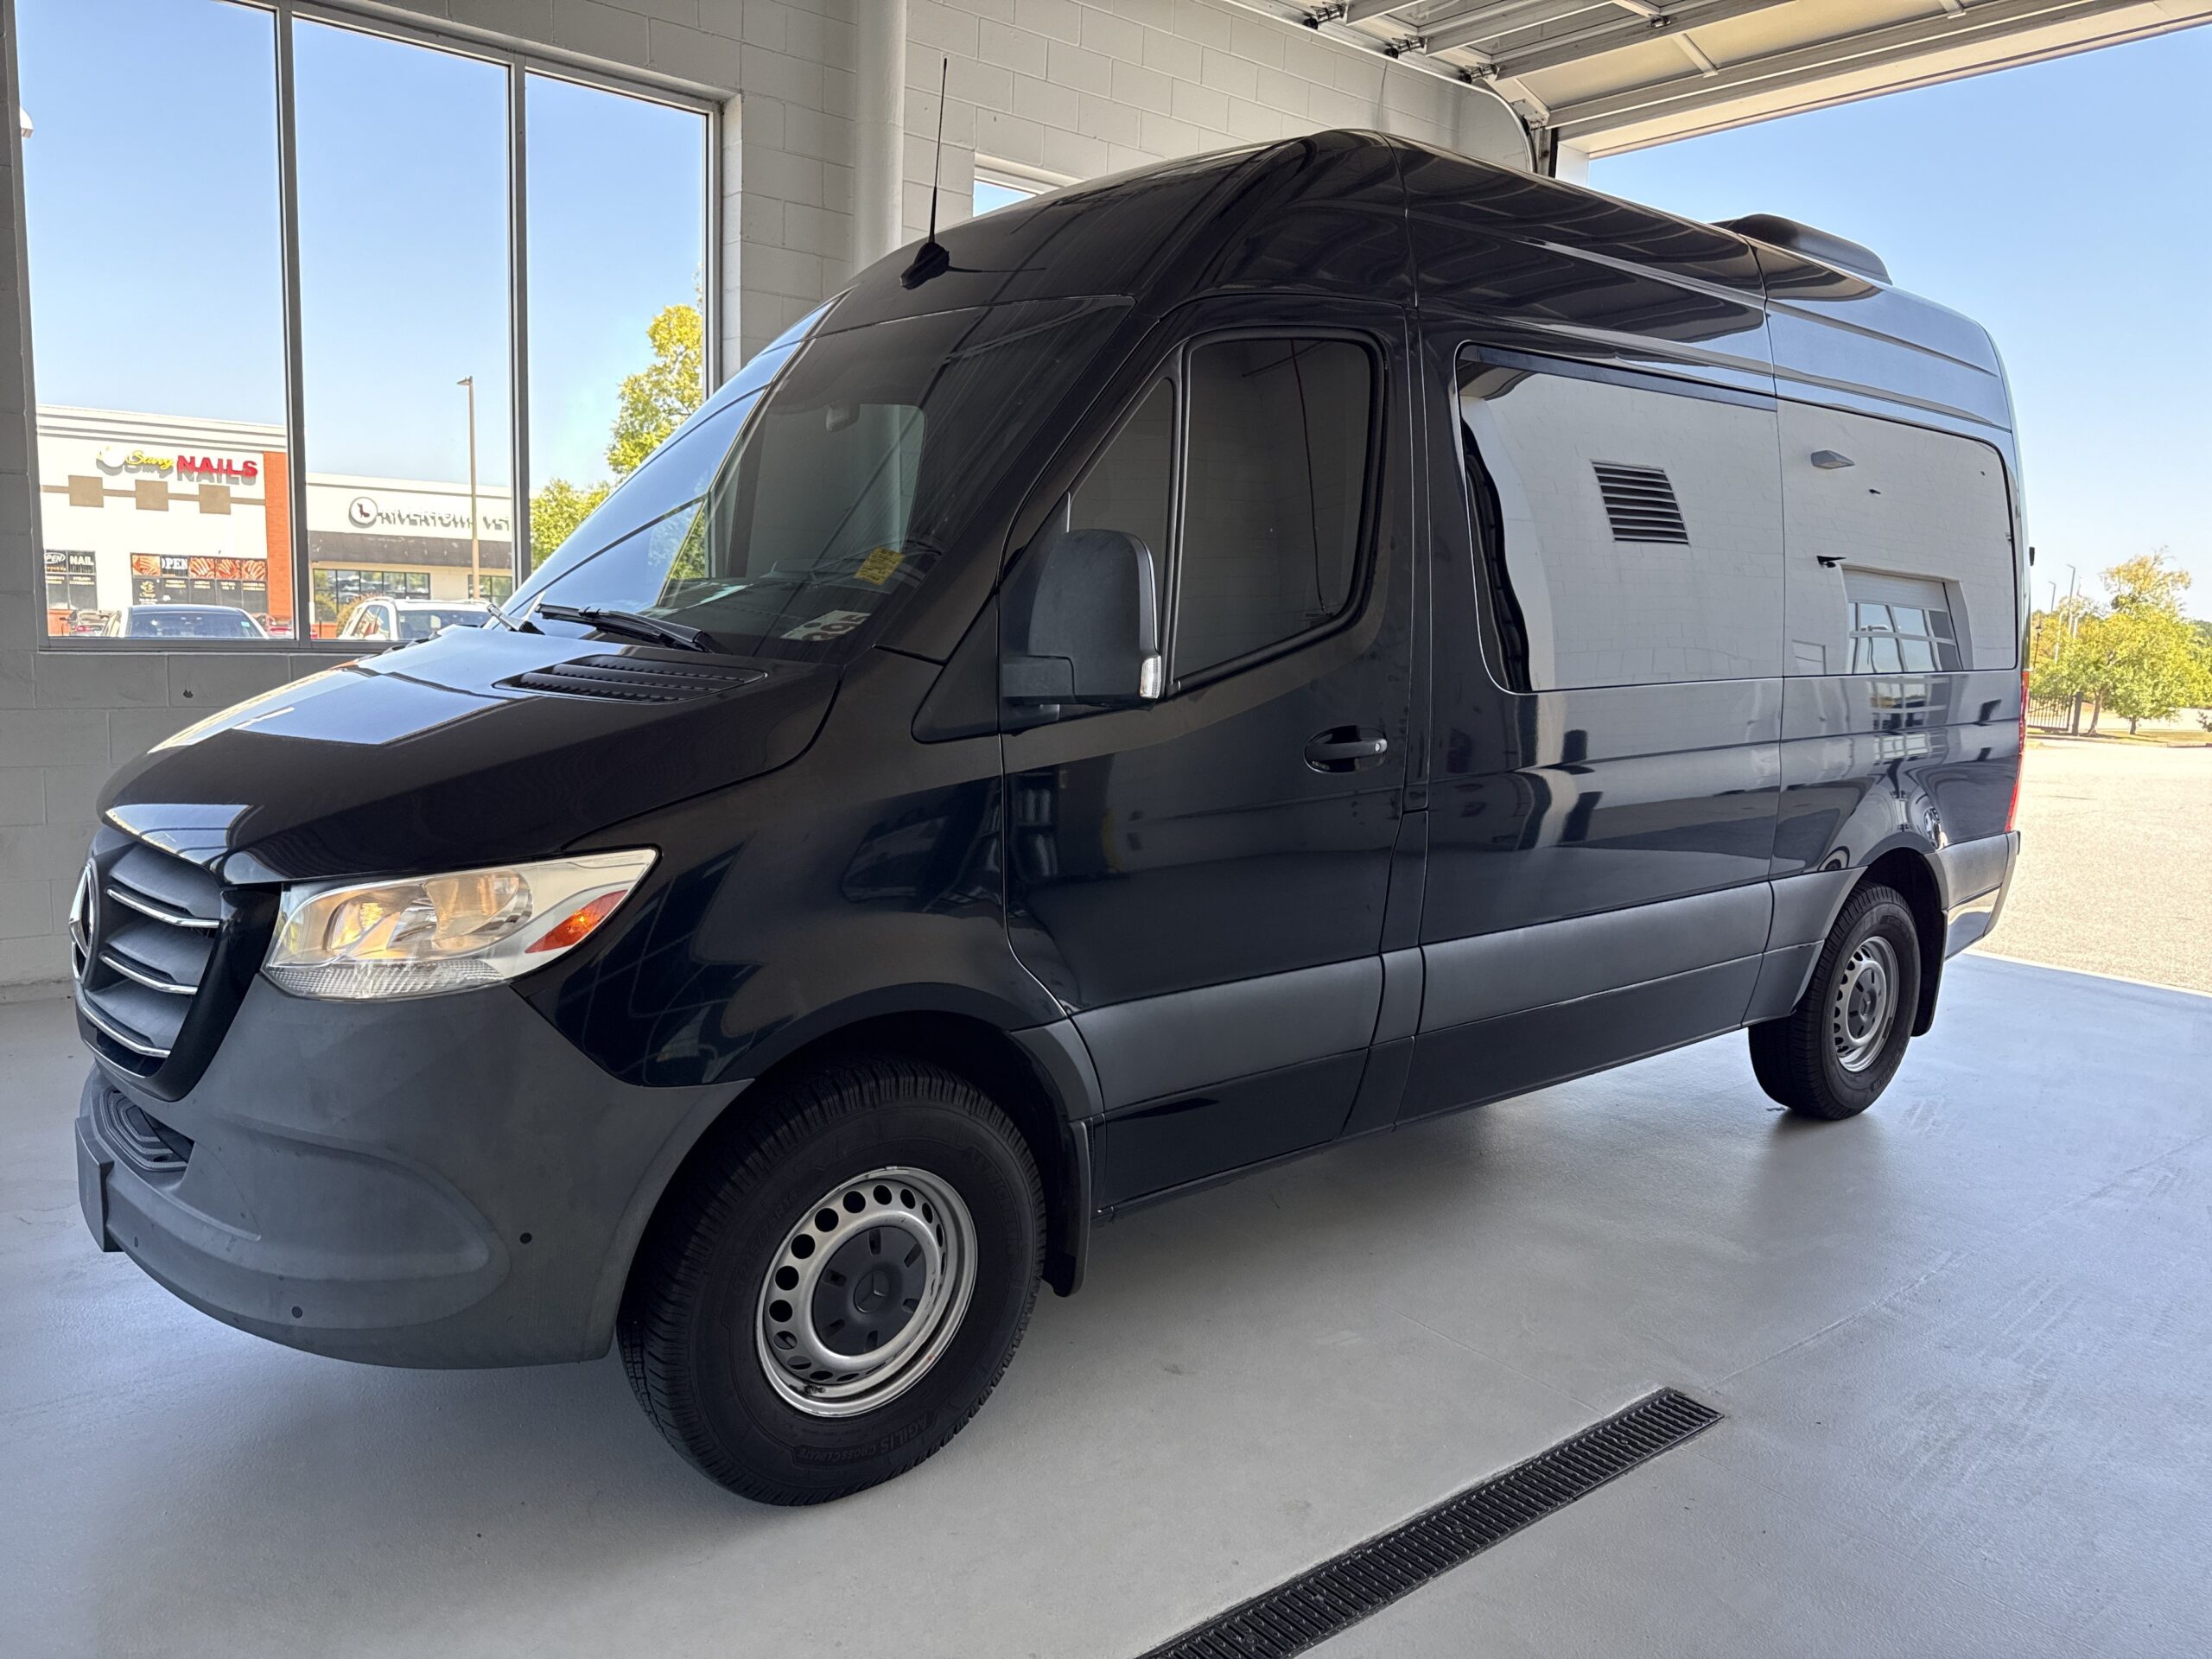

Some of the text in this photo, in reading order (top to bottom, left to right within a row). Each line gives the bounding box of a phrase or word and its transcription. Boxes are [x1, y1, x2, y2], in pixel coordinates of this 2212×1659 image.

[177, 454, 258, 478] NAILS
[45, 554, 63, 563] PEN
[69, 556, 95, 566] NAIL
[797, 1413, 928, 1463] AGILIS CROSSCLIMATE
